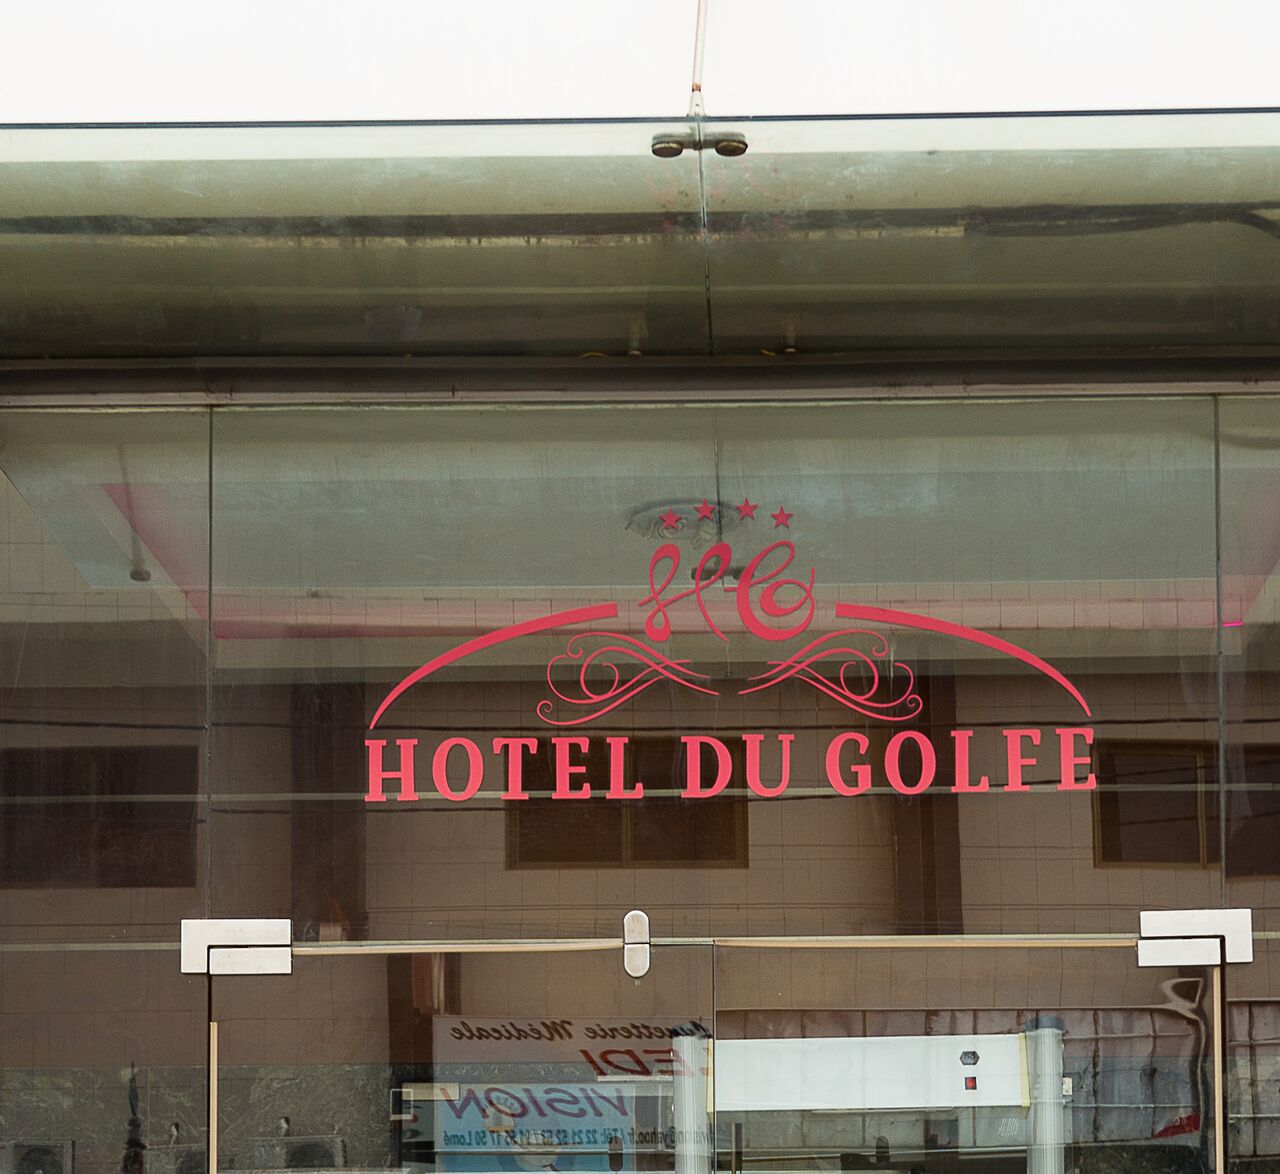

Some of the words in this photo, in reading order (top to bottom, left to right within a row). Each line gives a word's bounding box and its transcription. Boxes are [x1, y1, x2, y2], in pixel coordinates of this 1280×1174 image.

[365, 737, 644, 801] HOTEL
[681, 734, 794, 798] DU
[825, 728, 1097, 796] GOLFE
